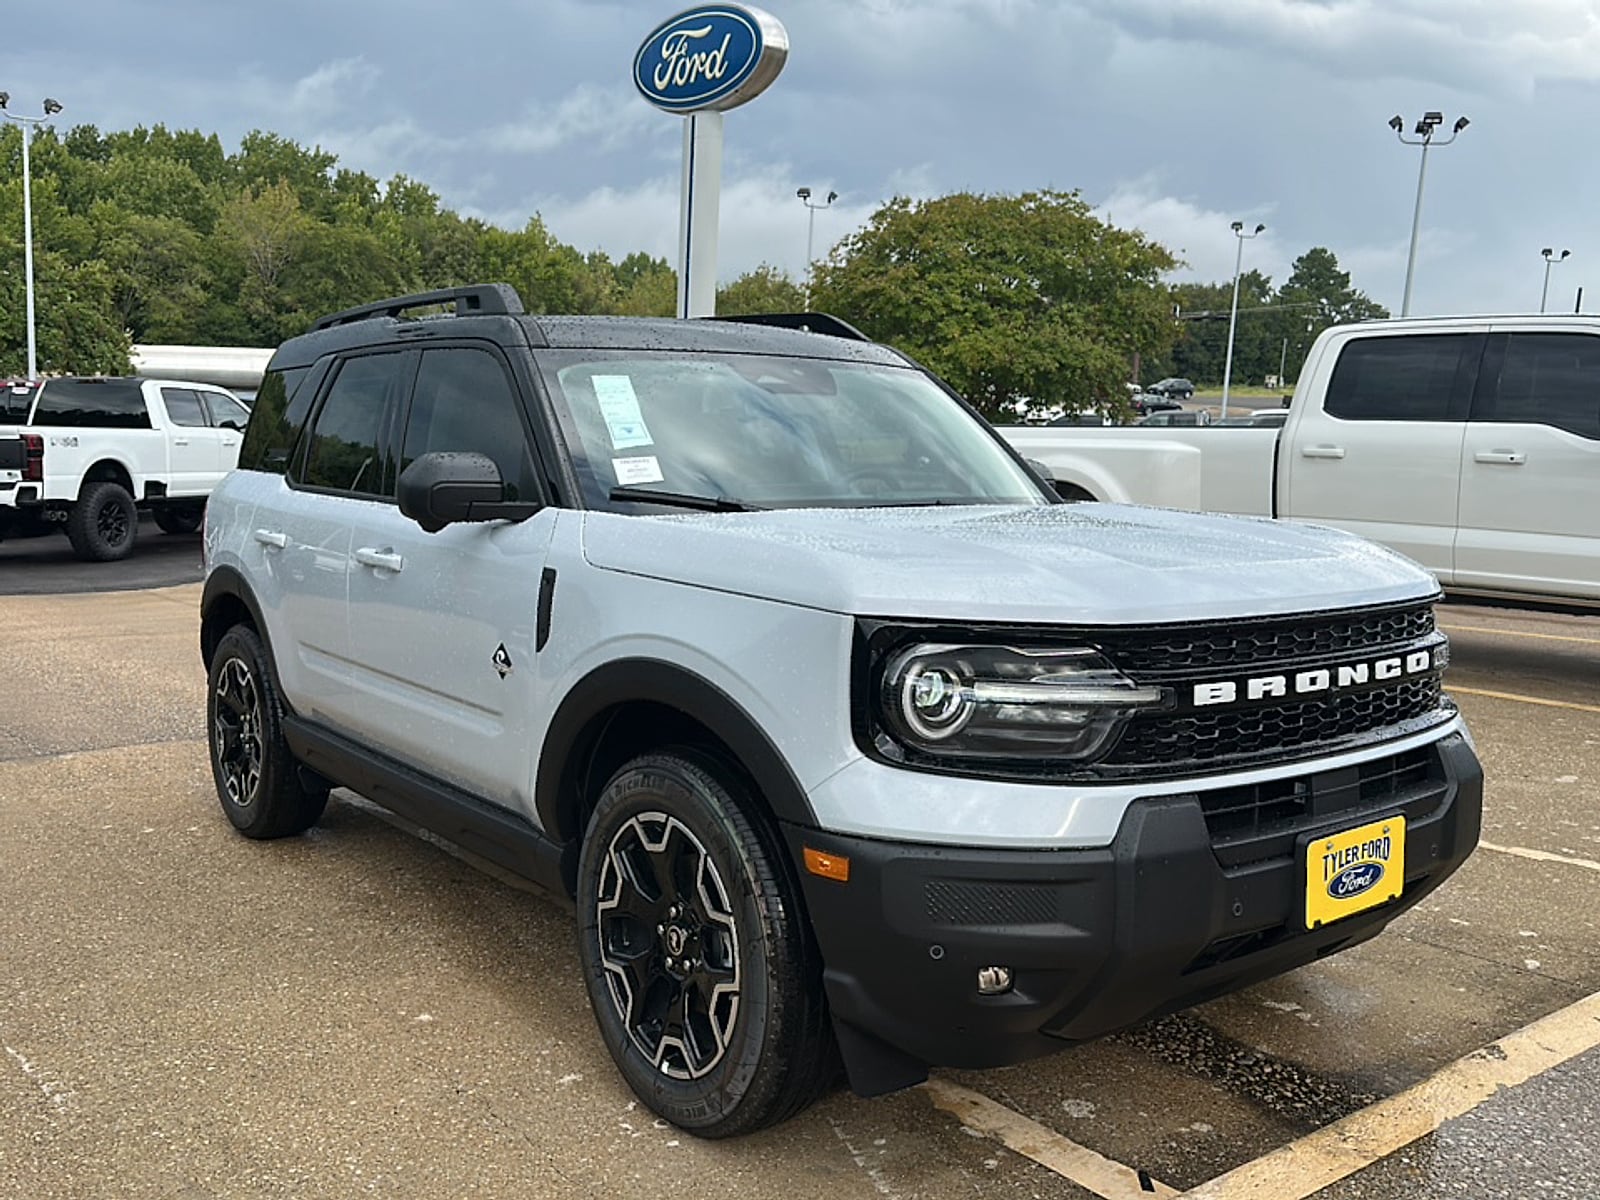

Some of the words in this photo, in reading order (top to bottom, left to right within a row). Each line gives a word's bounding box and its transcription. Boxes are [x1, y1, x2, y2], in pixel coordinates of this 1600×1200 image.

[654, 24, 731, 90] Ford
[1193, 650, 1430, 706] BRONCO
[1322, 844, 1360, 882] TYLER
[1361, 836, 1391, 861] FORD
[1338, 866, 1375, 894] Ford
